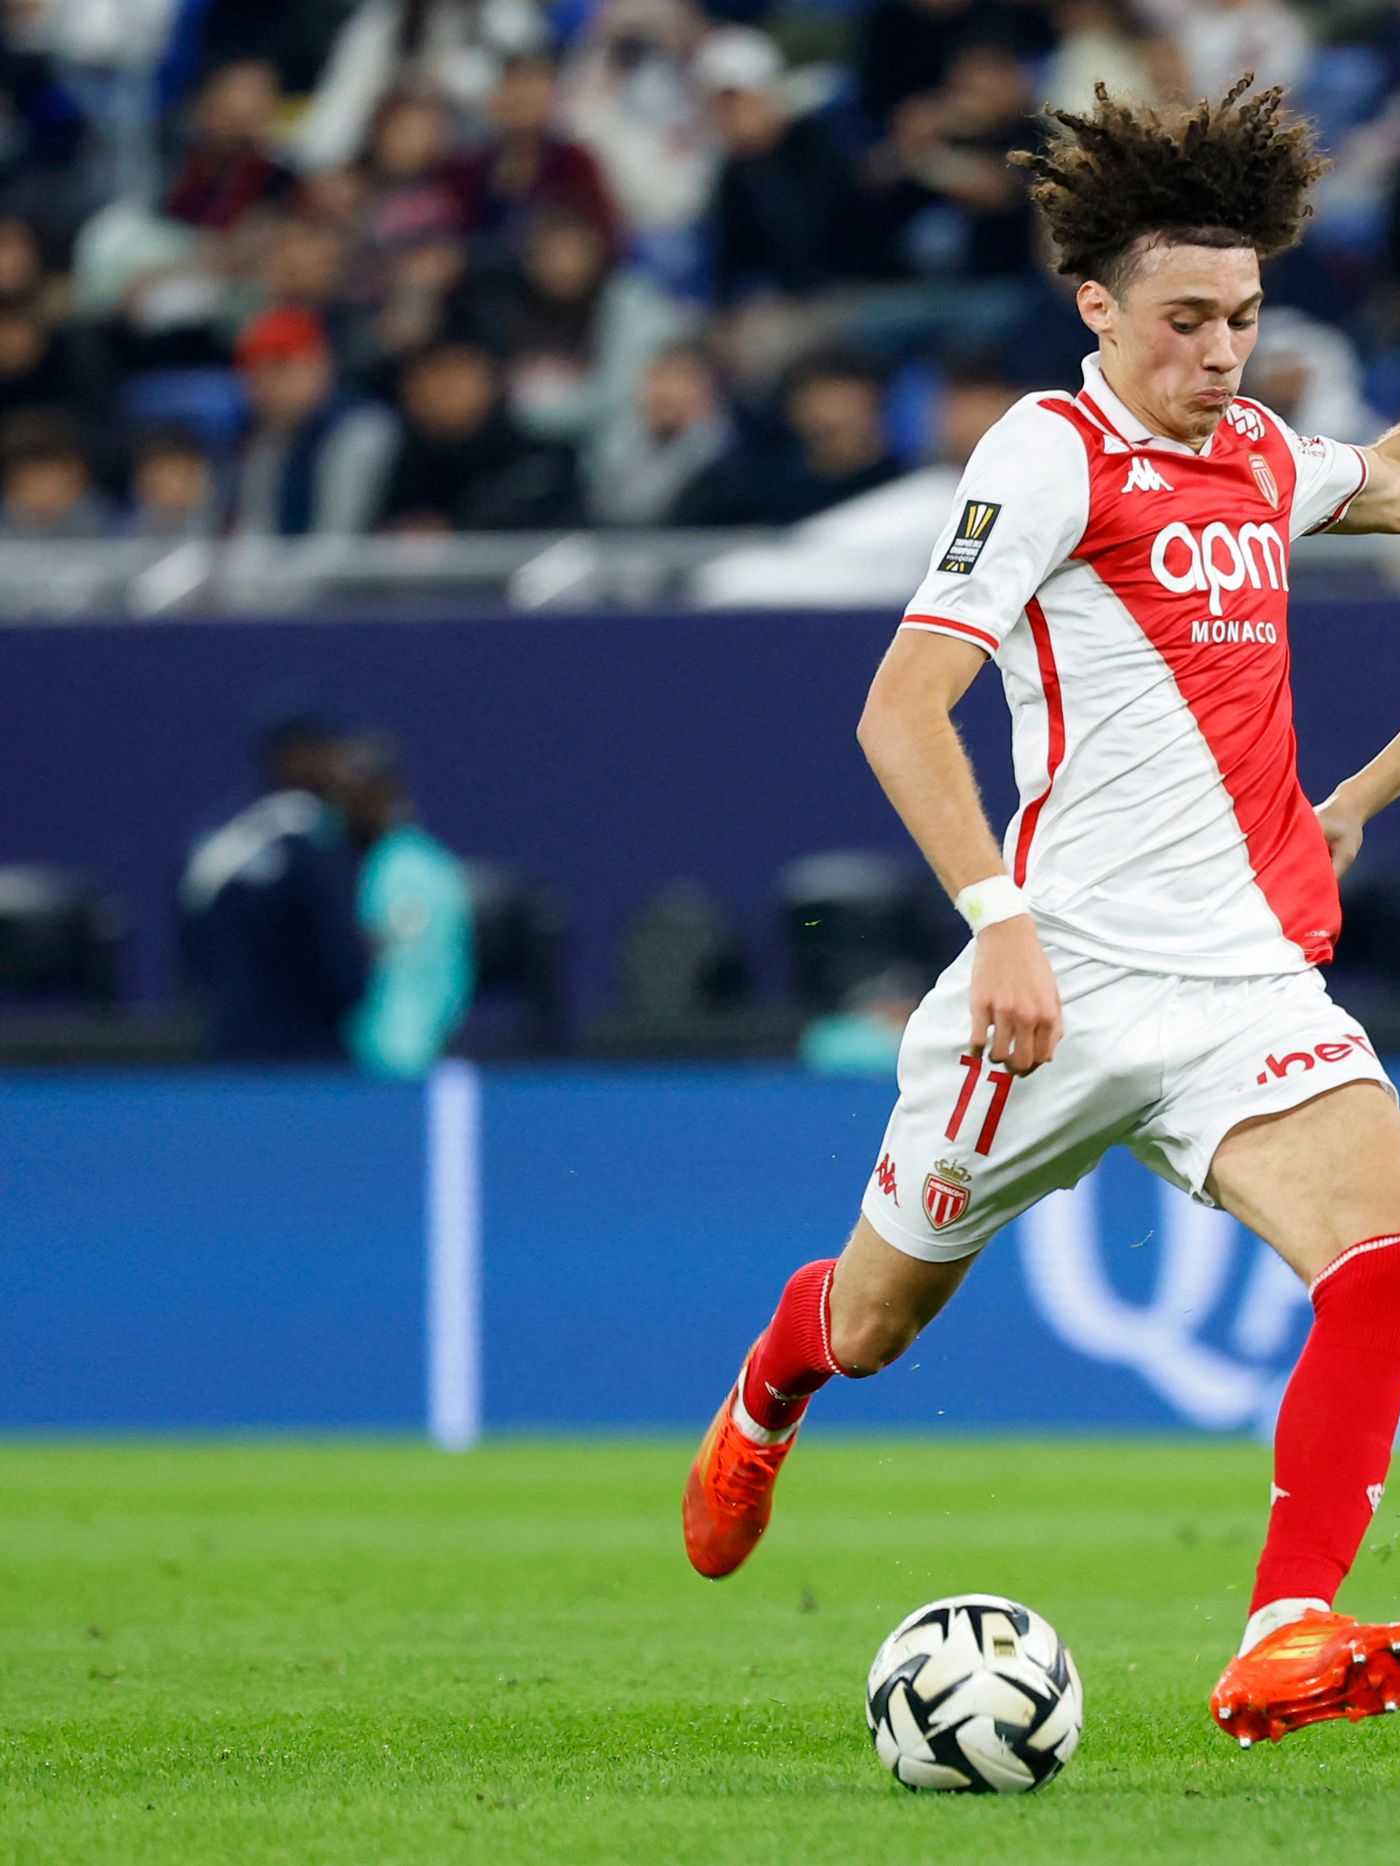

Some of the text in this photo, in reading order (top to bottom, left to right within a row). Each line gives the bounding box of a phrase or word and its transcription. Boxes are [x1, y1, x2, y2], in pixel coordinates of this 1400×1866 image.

[1151, 521, 1290, 617] apm
[1191, 620, 1278, 645] MONACO
[944, 1054, 1015, 1157] 11
